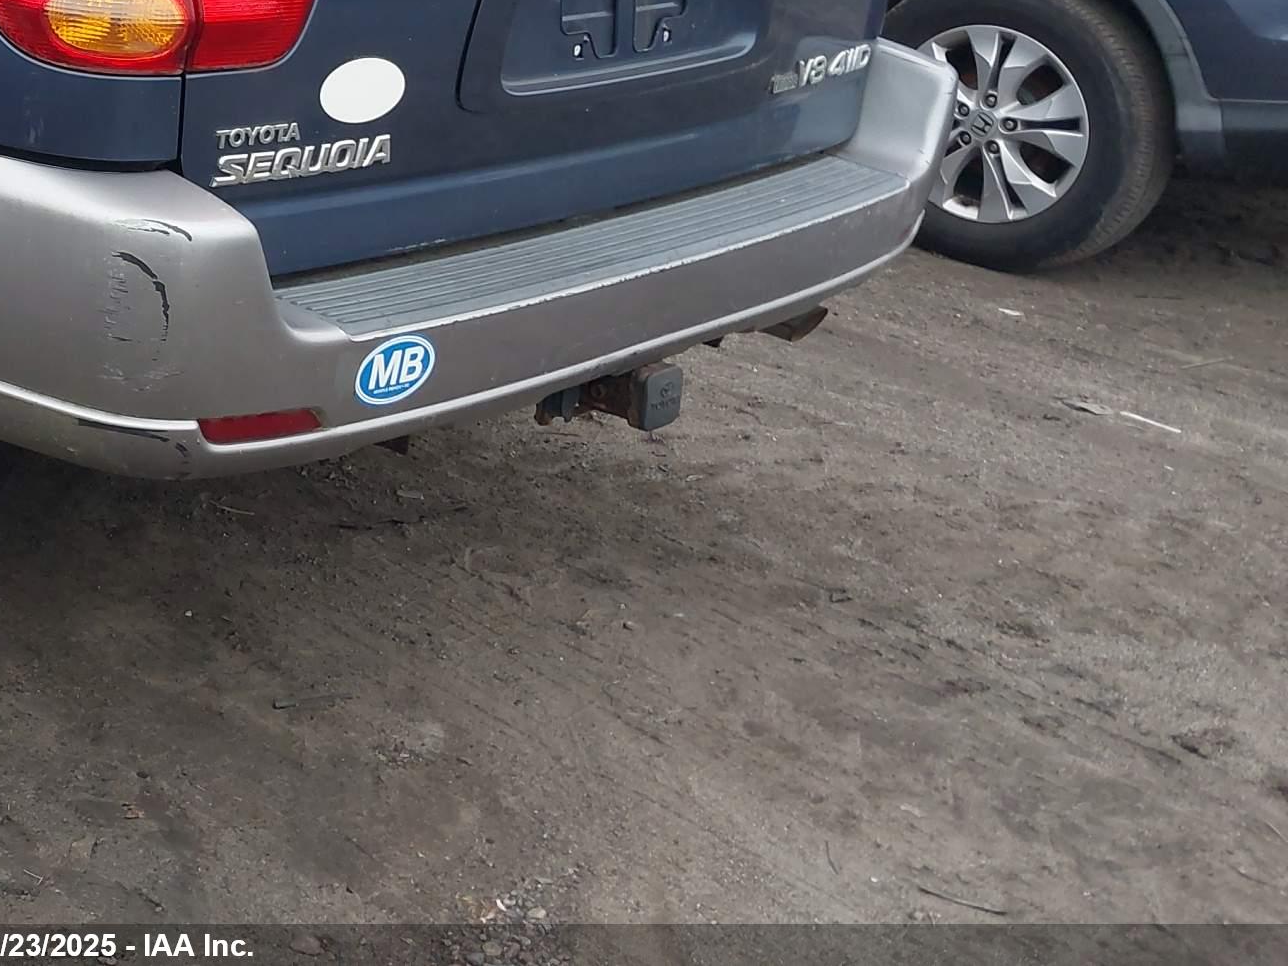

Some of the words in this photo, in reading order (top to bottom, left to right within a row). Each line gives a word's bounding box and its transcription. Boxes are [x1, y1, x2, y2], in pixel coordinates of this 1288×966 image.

[798, 55, 827, 87] V8
[215, 122, 302, 149] TOYOTA
[209, 134, 391, 187] SEQUOIA
[368, 345, 425, 390] MB
